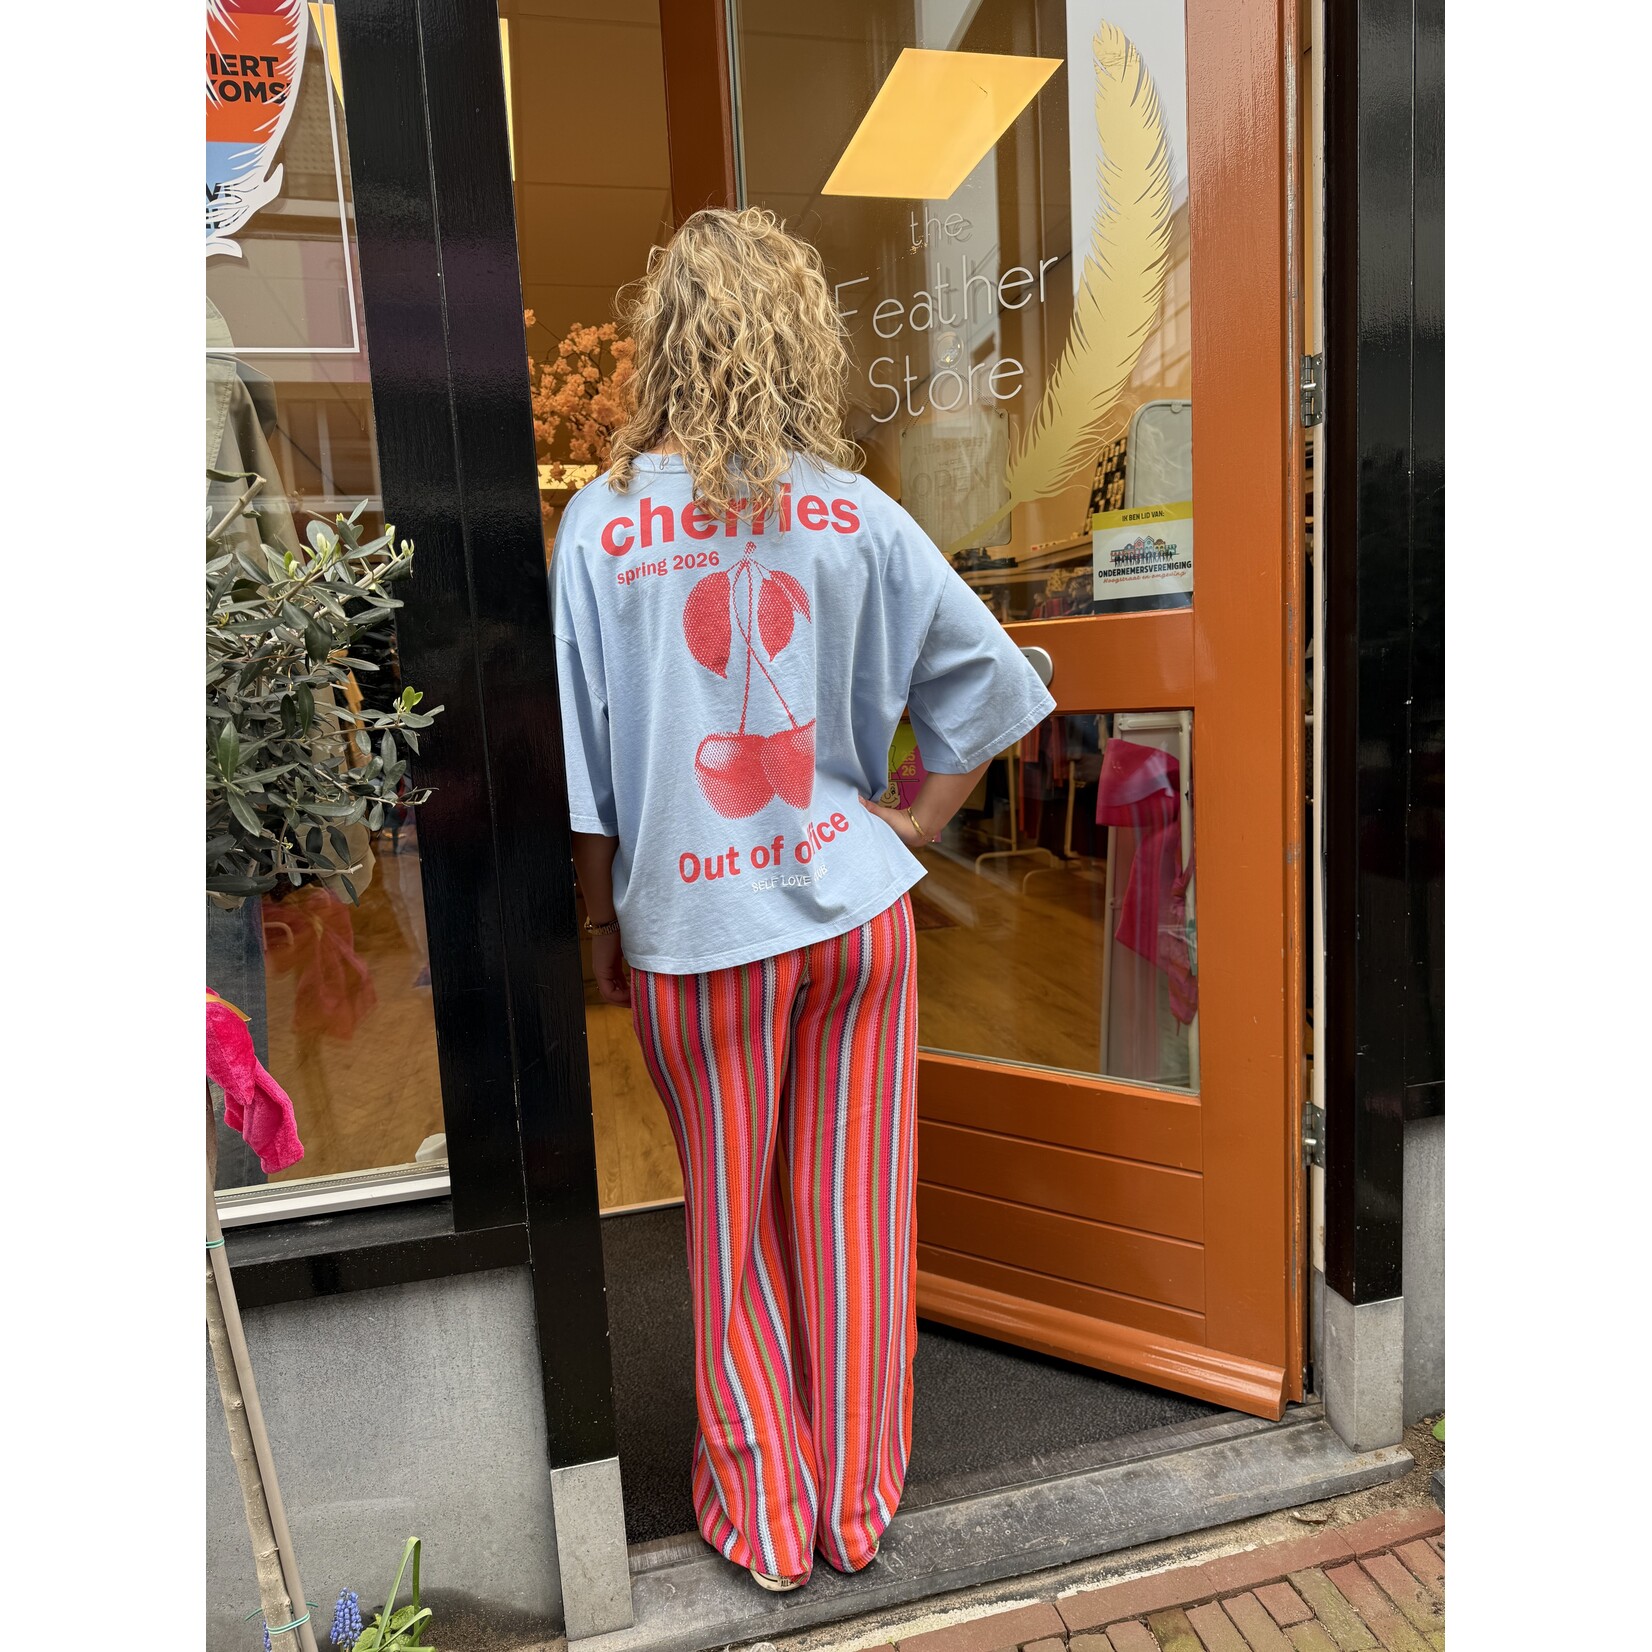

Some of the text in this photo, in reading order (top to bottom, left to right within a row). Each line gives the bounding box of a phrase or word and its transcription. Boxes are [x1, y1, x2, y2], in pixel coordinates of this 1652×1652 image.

[206, 53, 279, 77] IERT
[206, 80, 291, 104] OMS
[910, 207, 963, 246] the
[835, 255, 1058, 339] Feather
[869, 355, 1024, 423] Store
[912, 462, 991, 497] OPEN
[601, 483, 861, 557] cherries
[1141, 512, 1151, 520] LID
[1151, 510, 1165, 518] VAN:
[617, 551, 720, 586] spring 2026
[1098, 561, 1192, 578] ONDERNEMERSVERENIGING
[901, 765, 916, 776] 26
[679, 812, 850, 884] Out of oice
[752, 876, 780, 893] SELF
[781, 875, 811, 887] LOVE
